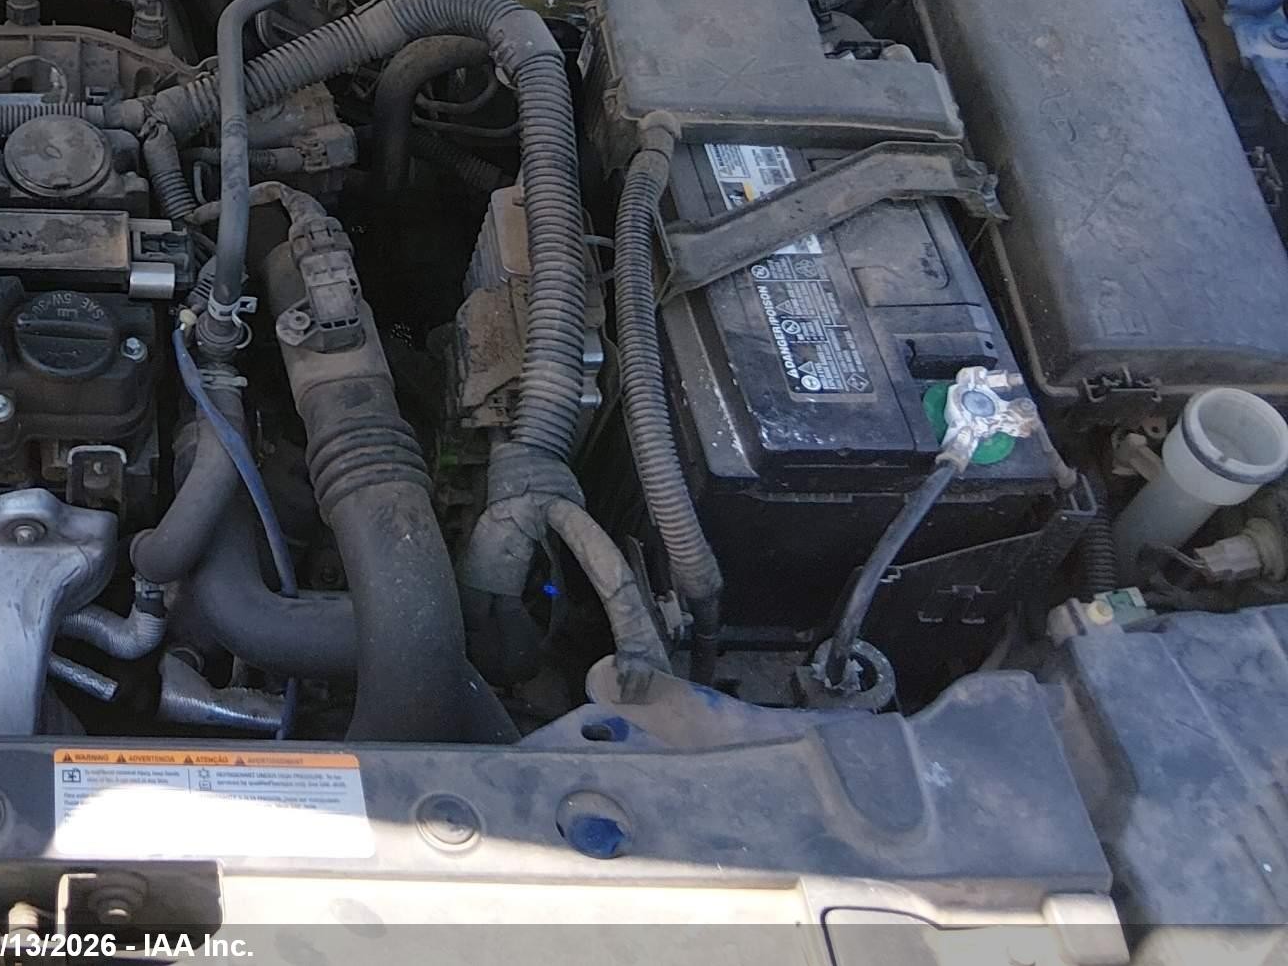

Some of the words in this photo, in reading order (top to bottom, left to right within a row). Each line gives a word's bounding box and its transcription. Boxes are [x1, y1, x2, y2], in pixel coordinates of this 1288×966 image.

[82, 297, 105, 319] SAE
[756, 285, 797, 369] DANGER/POISON
[74, 754, 109, 763] WARNING
